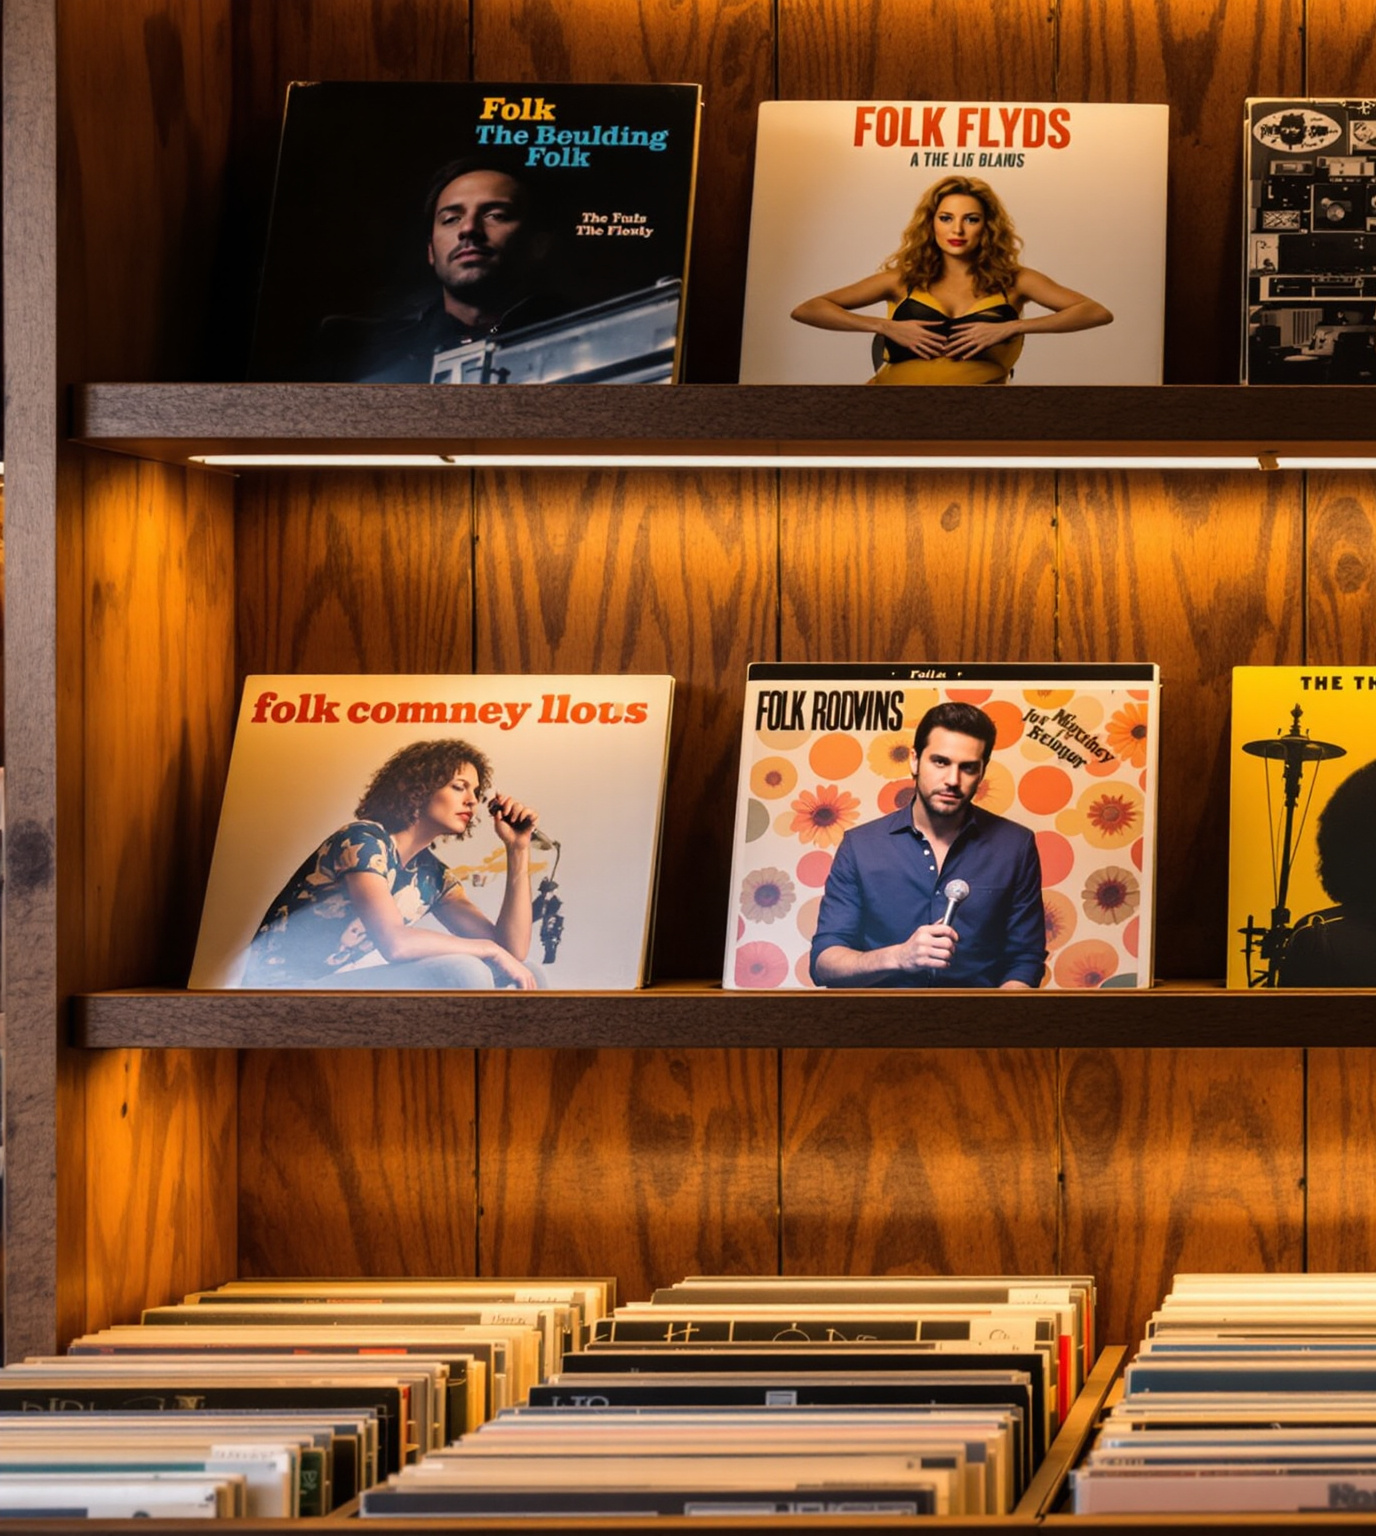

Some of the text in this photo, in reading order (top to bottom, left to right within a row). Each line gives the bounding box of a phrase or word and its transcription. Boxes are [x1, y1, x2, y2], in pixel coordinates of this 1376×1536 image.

[480, 97, 556, 121] Folk
[476, 125, 669, 151] The Beulding
[854, 106, 1071, 149] FOLK FLYDS
[525, 147, 590, 167] Folk
[924, 152, 949, 167] THE
[1301, 676, 1343, 691] THE
[251, 692, 340, 723] folk
[347, 701, 532, 730] comney
[755, 690, 807, 731] FOLK
